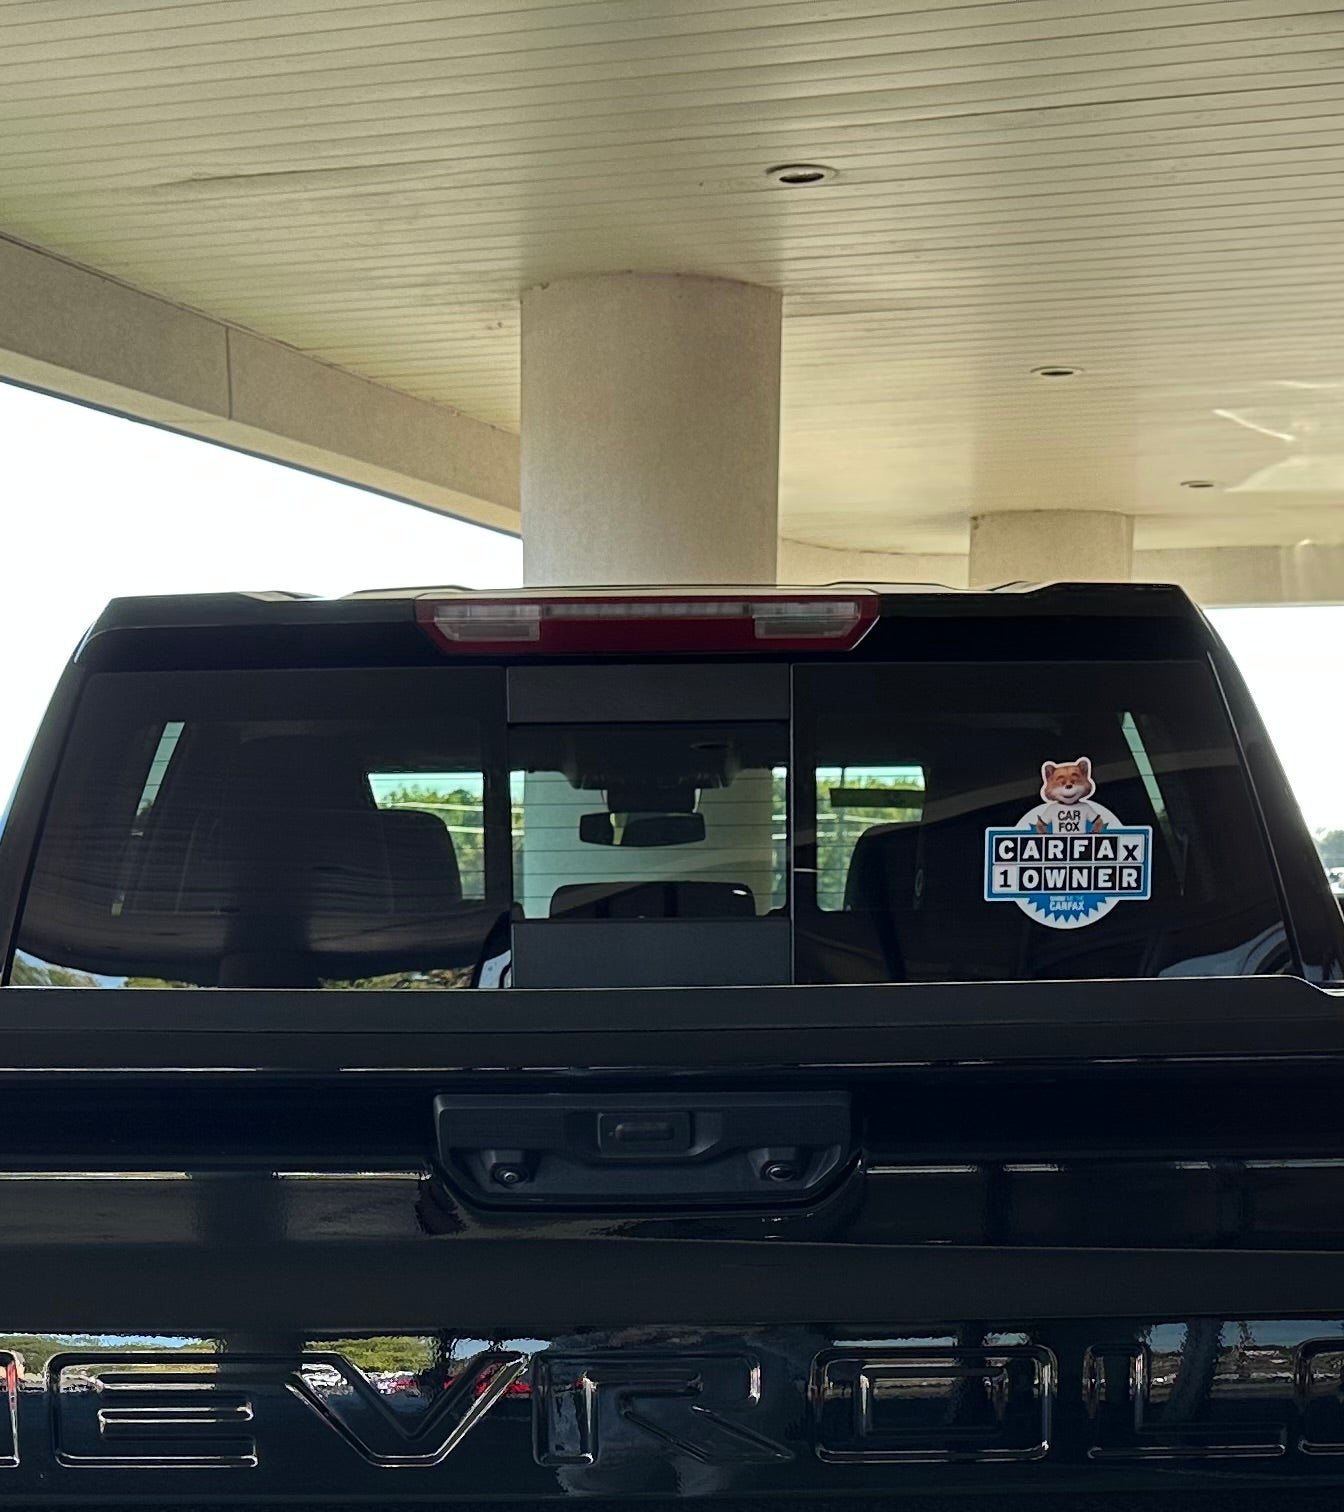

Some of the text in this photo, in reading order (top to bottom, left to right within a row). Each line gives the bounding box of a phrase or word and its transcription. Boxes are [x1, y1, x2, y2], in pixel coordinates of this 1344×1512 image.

[1057, 810, 1081, 821] CAR
[1058, 822, 1080, 832] FOX
[998, 839, 1138, 861] CARFAX
[1049, 901, 1085, 911] CARFAX
